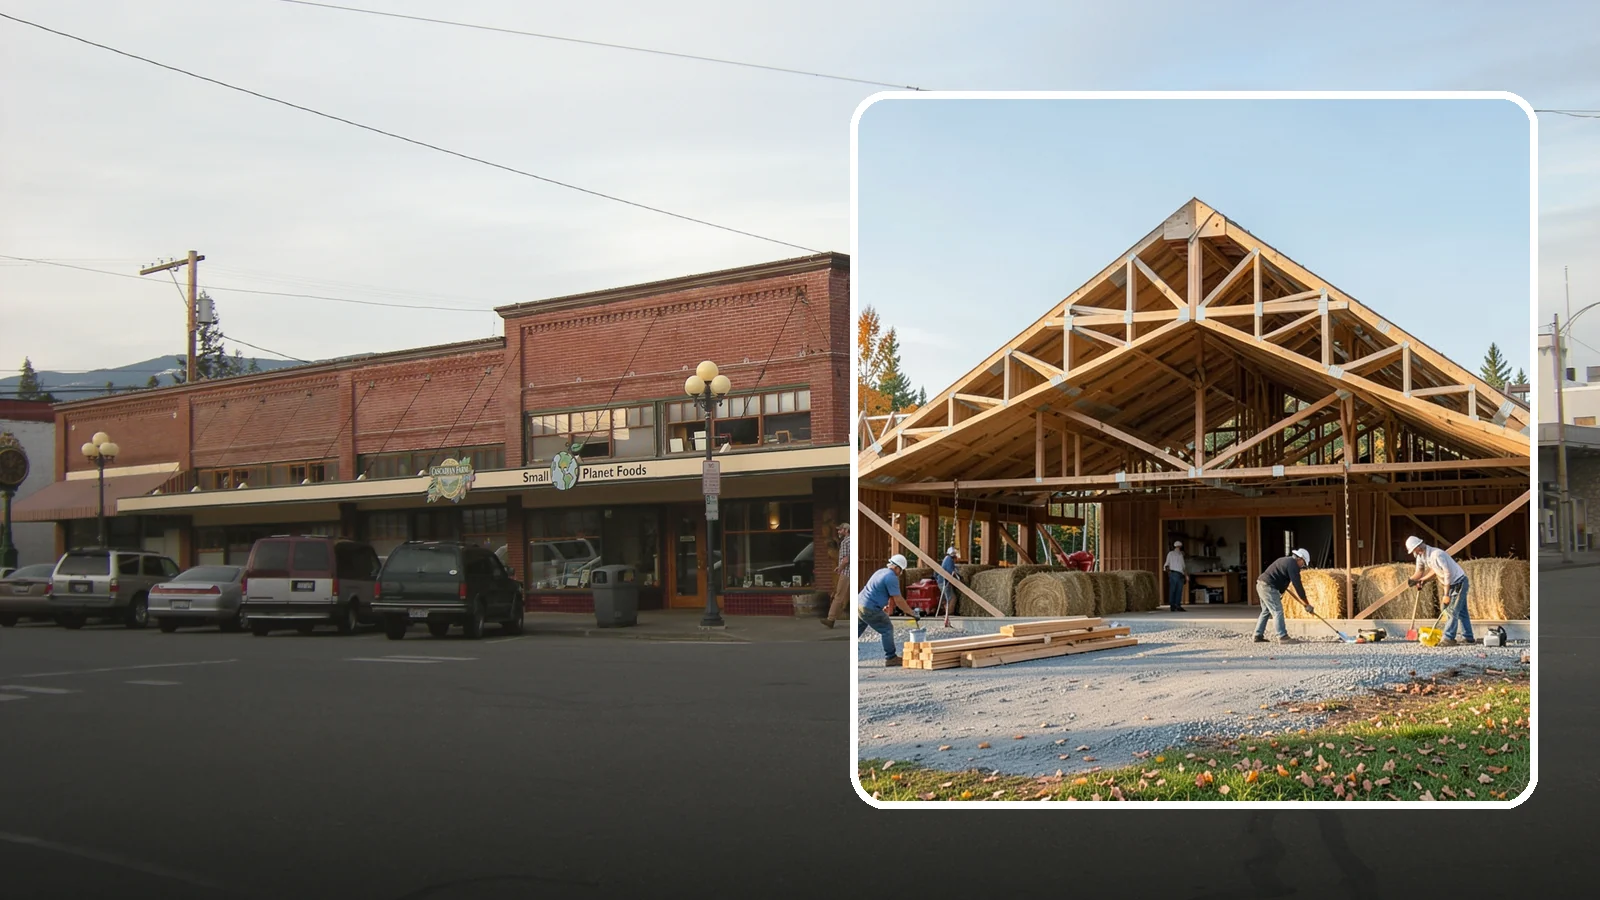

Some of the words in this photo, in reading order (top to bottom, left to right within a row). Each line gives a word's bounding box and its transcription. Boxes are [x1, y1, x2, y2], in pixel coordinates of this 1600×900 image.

[523, 471, 549, 483] Small
[582, 467, 614, 479] Planet
[616, 463, 647, 477] Foods
